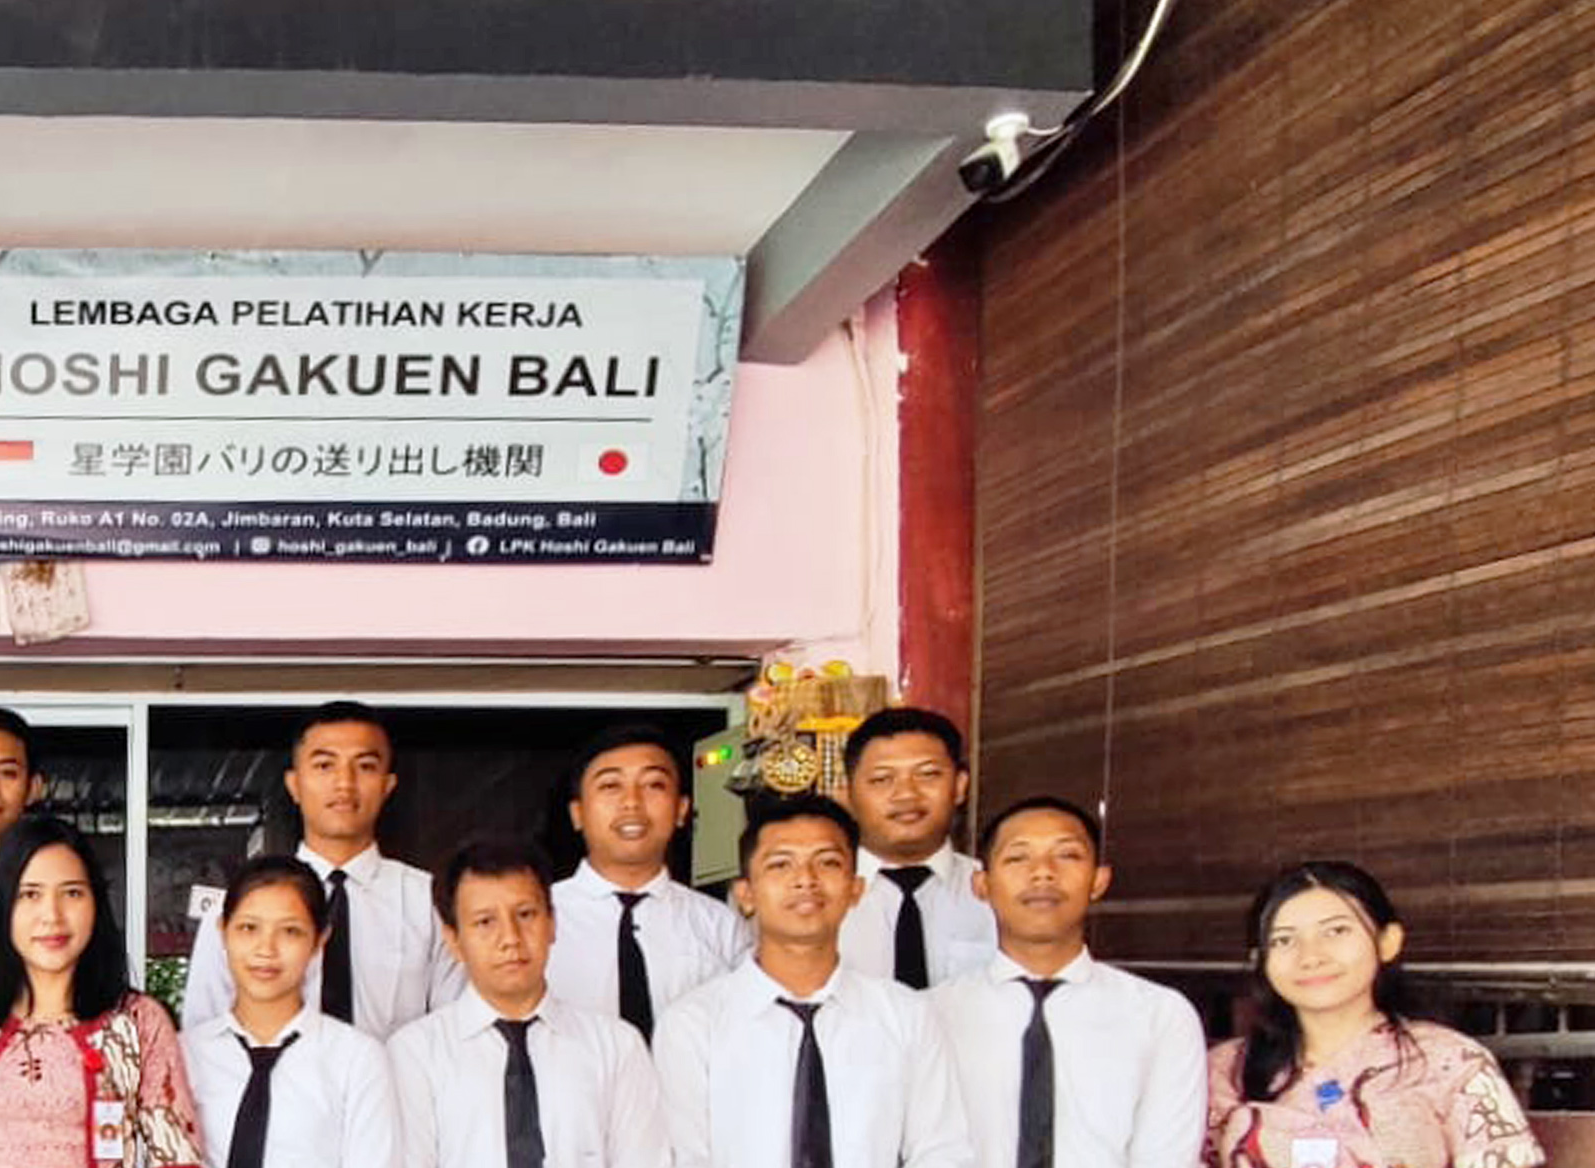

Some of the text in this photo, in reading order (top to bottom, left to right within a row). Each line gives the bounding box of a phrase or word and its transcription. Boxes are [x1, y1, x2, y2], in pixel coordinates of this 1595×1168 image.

[30, 300, 583, 328] LEMBAGA PELATIHAN KERJA
[196, 353, 481, 397] GAKUEN
[507, 354, 660, 398] BALI
[68, 442, 544, 478] 星学園バリの送り出し機関
[41, 511, 93, 526] Ruko
[99, 511, 124, 527] A1
[131, 511, 164, 527] No.
[221, 510, 321, 529] Jimbaran,
[327, 511, 374, 527] Kuta
[380, 511, 460, 529] Selatan,
[557, 511, 597, 527] Bali
[499, 539, 536, 554] LPK
[540, 539, 591, 554] Hoshi
[593, 539, 658, 555] Gakuen
[662, 539, 696, 554] Bali
